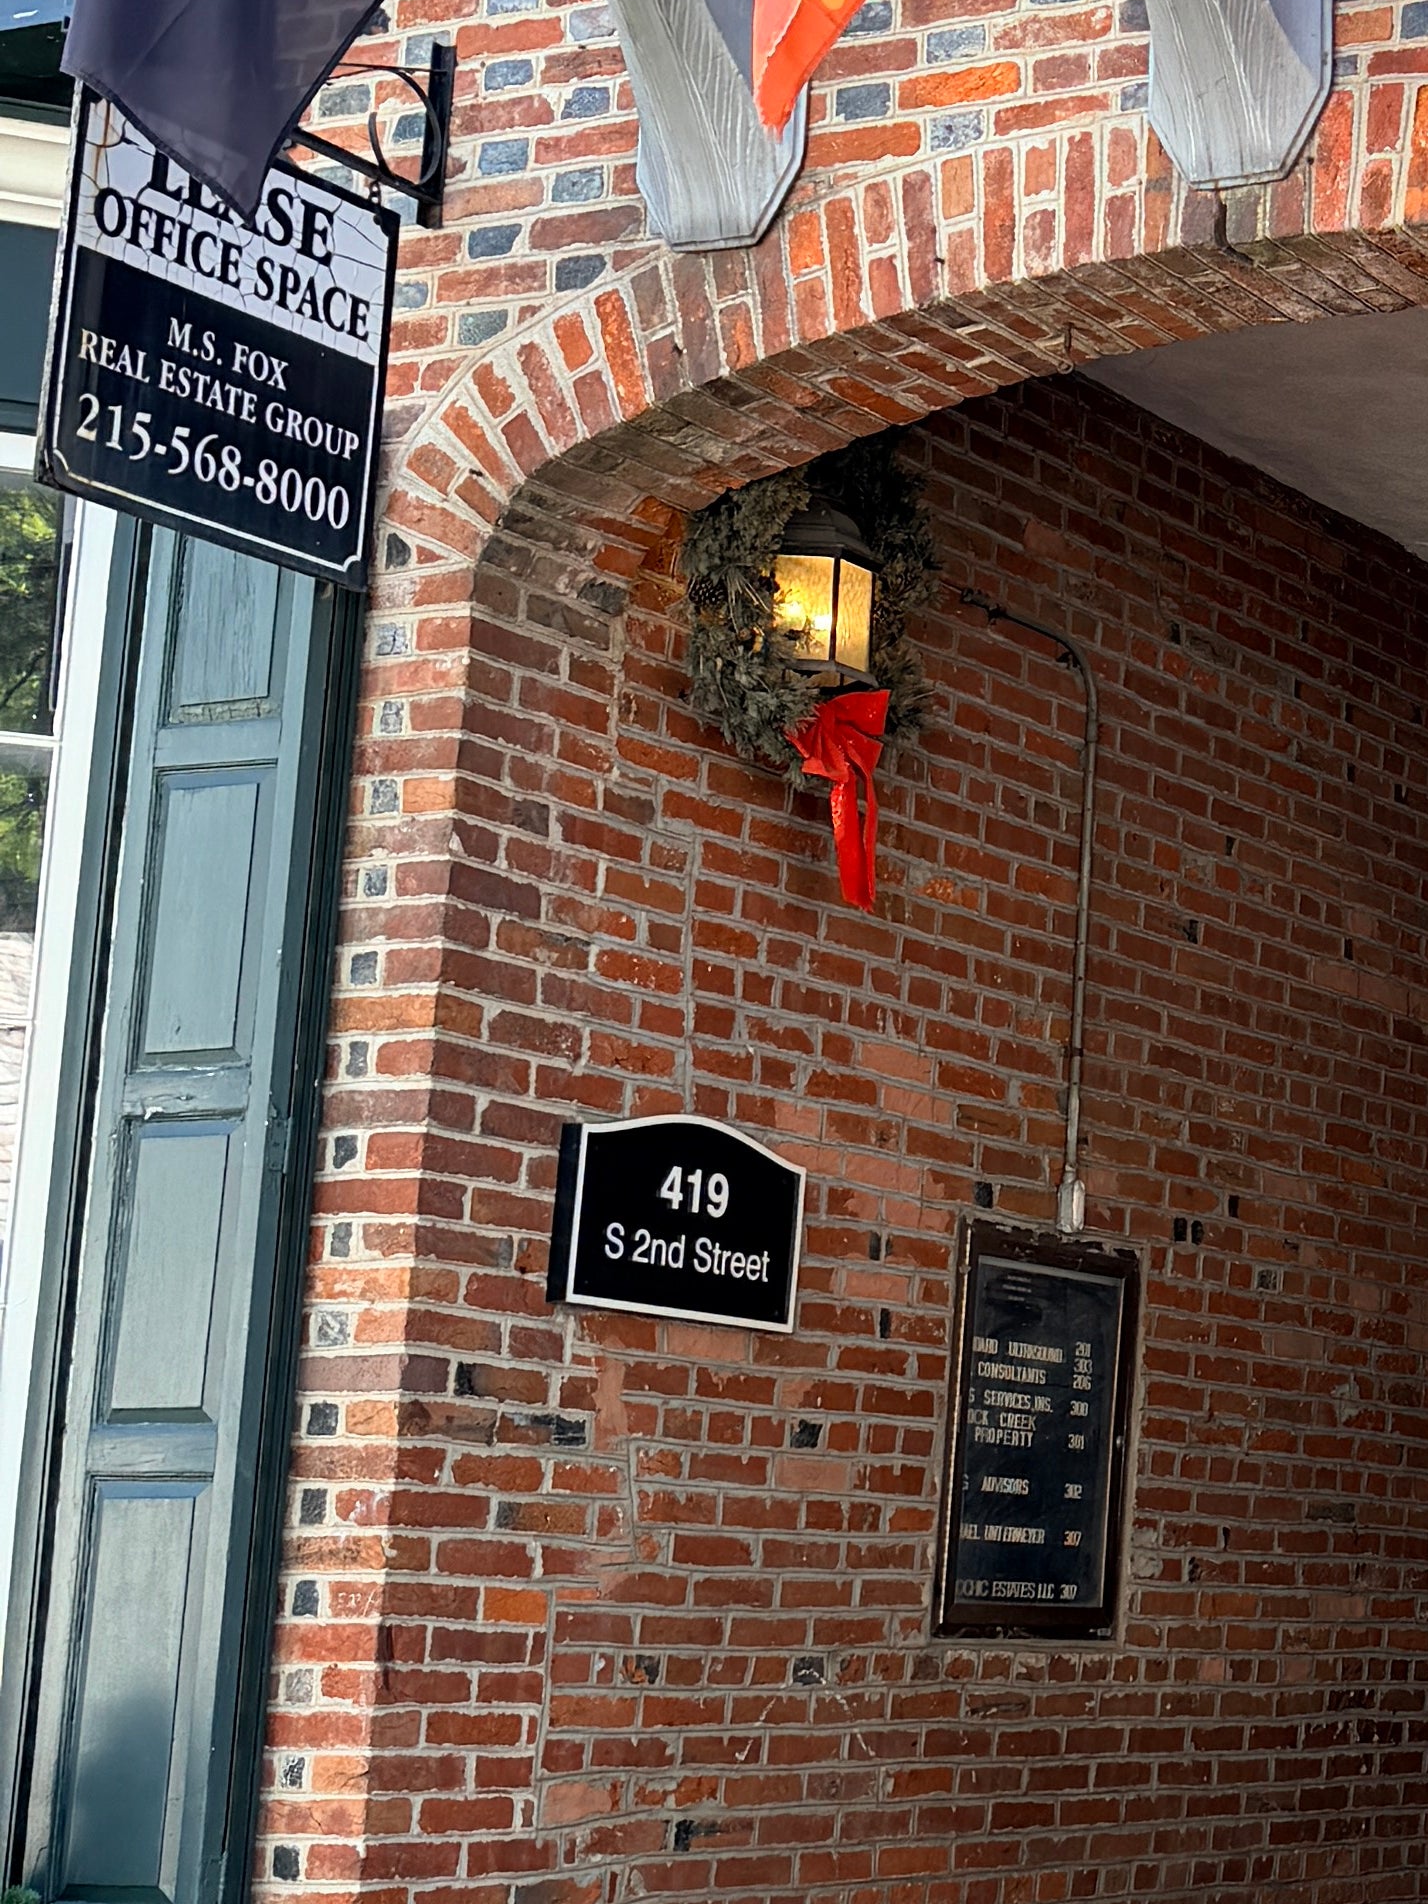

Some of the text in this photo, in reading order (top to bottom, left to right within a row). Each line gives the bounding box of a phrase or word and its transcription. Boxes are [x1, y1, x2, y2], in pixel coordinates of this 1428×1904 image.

[94, 187, 370, 343] OFFICE SPACE
[167, 317, 289, 391] M.S. FOX
[78, 328, 359, 461] REAL ESTATE GROUP
[75, 393, 350, 530] 215-568-8000
[660, 1166, 729, 1218] 419
[604, 1222, 770, 1282] S 2nd Street
[974, 1427, 1034, 1448] PROPERTY
[999, 1412, 1037, 1431] CREEK
[992, 1581, 1035, 1598] ESTATES
